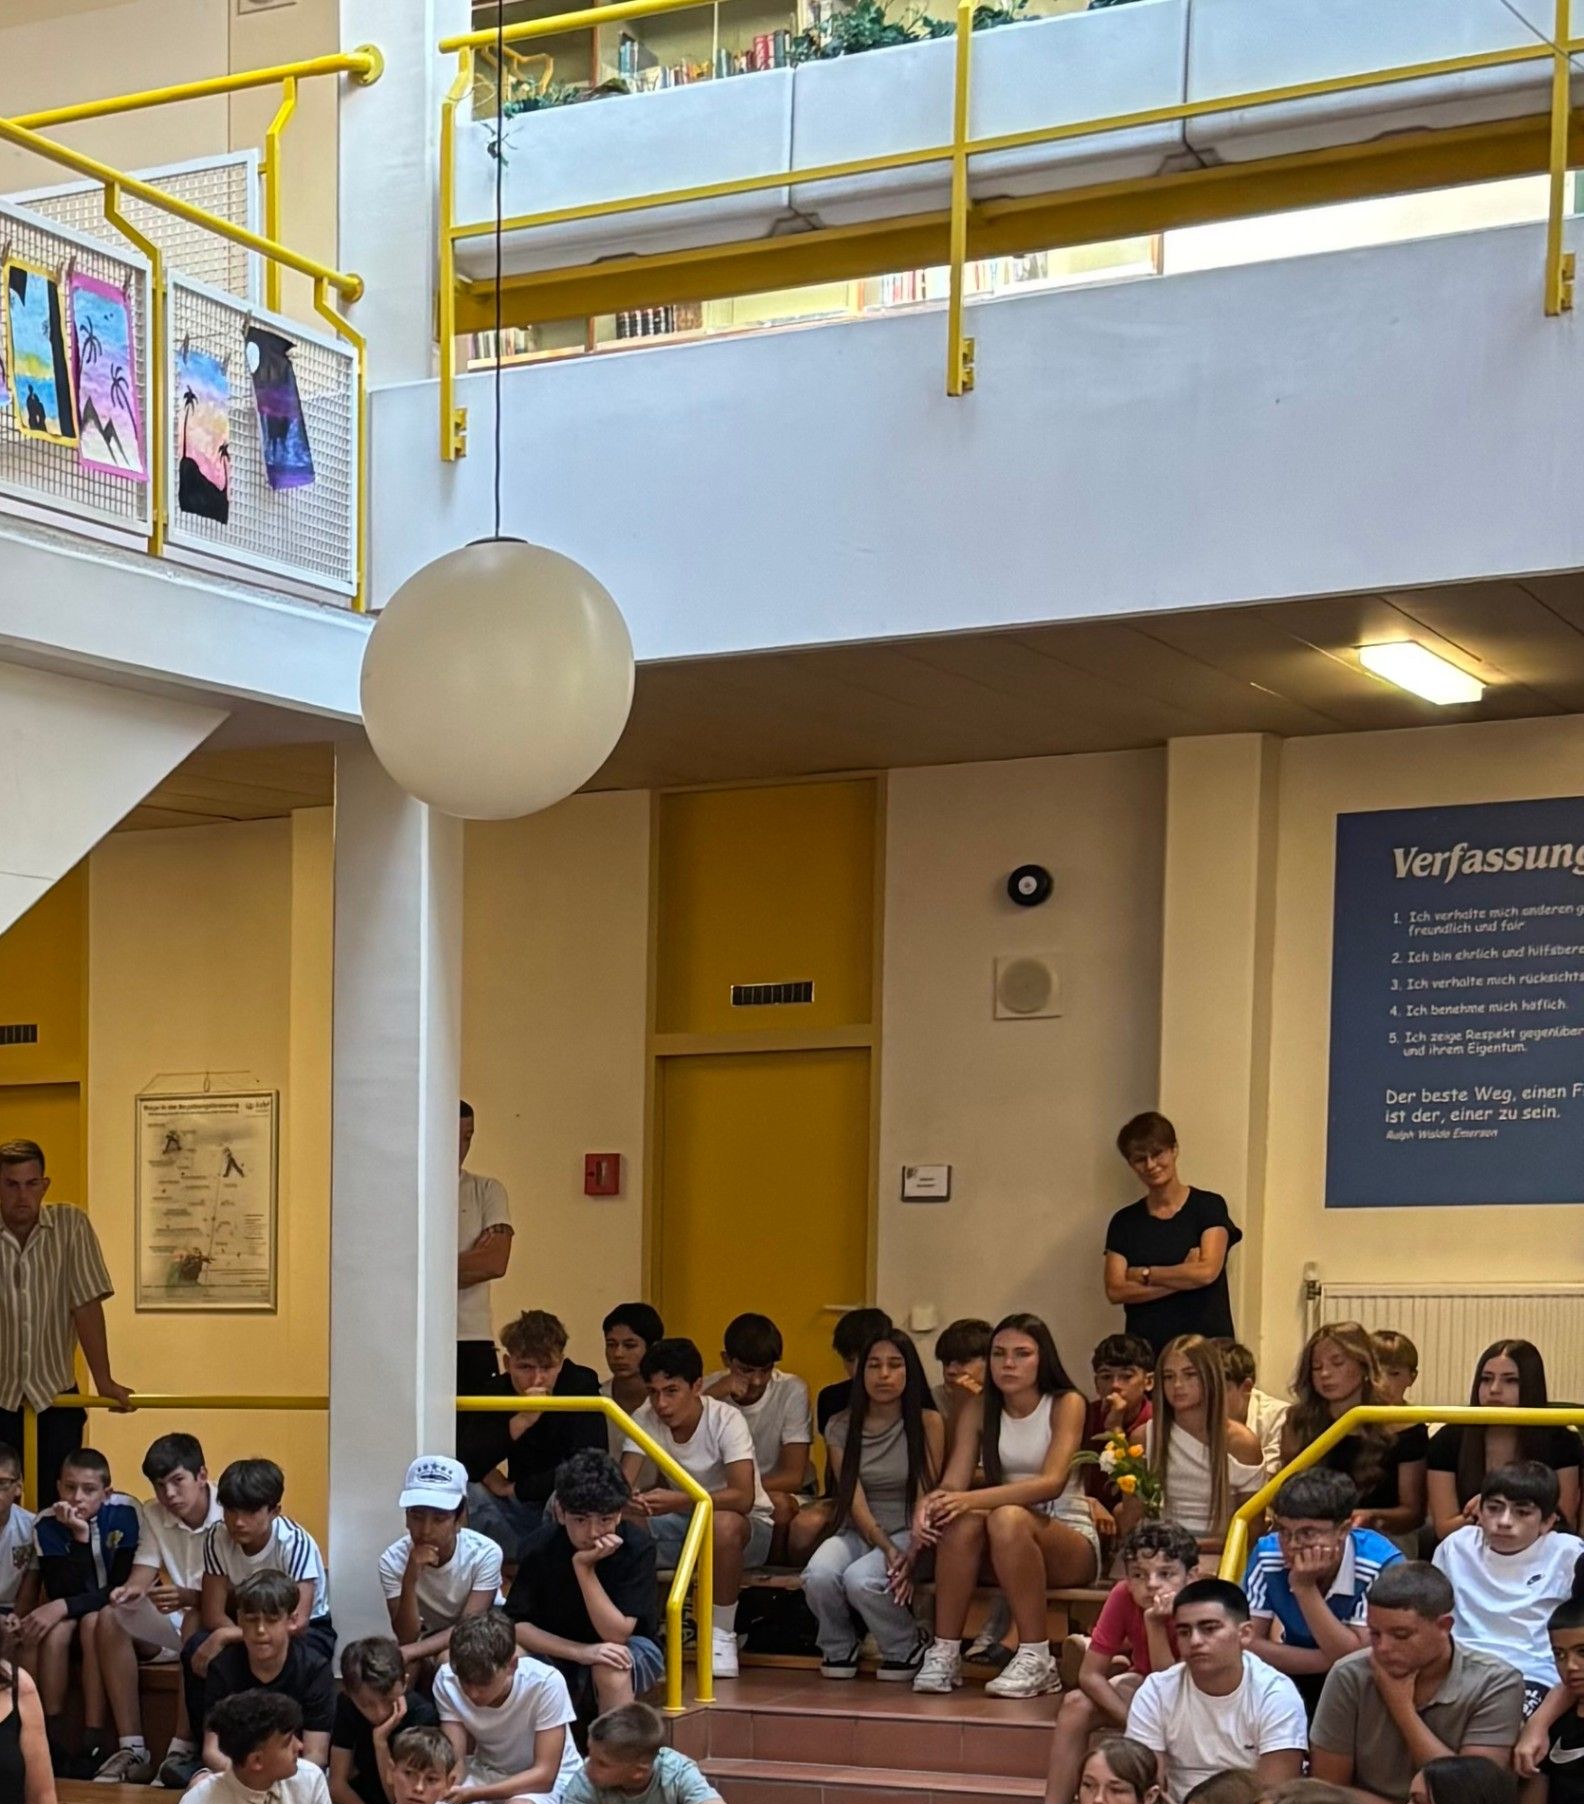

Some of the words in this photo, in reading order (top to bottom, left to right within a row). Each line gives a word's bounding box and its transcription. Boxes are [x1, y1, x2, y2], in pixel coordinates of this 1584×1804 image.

[1409, 910, 1430, 923] Ich
[1434, 908, 1485, 921] verhalte
[1489, 907, 1518, 919] mich
[1522, 904, 1574, 917] anderen
[1408, 922, 1471, 937] freundlich
[1475, 921, 1497, 933] und
[1407, 951, 1429, 964] Ich
[1432, 949, 1452, 962] bin
[1455, 947, 1499, 960] ehrlich
[1502, 946, 1525, 959] und
[1407, 978, 1428, 990] Ich
[1432, 975, 1483, 989] verhalte
[1486, 973, 1516, 987] mich
[1406, 1004, 1427, 1017] Ich
[1431, 1002, 1485, 1016] benehme
[1489, 1000, 1518, 1013] mich
[1405, 1031, 1426, 1044] Ich
[1430, 1031, 1462, 1045] zeige
[1465, 1028, 1516, 1043] Respekt
[1403, 1045, 1426, 1057] und
[1429, 1044, 1464, 1056] ihrem
[1386, 1088, 1416, 1104] Der
[1422, 1087, 1468, 1103] beste
[1474, 1085, 1517, 1104] Weg,
[1522, 1084, 1566, 1100] einen
[1385, 1108, 1405, 1124] ist
[1411, 1108, 1446, 1125] der,
[1450, 1106, 1493, 1122] einer
[1498, 1108, 1518, 1121] zu
[1522, 1104, 1561, 1120] sein.
